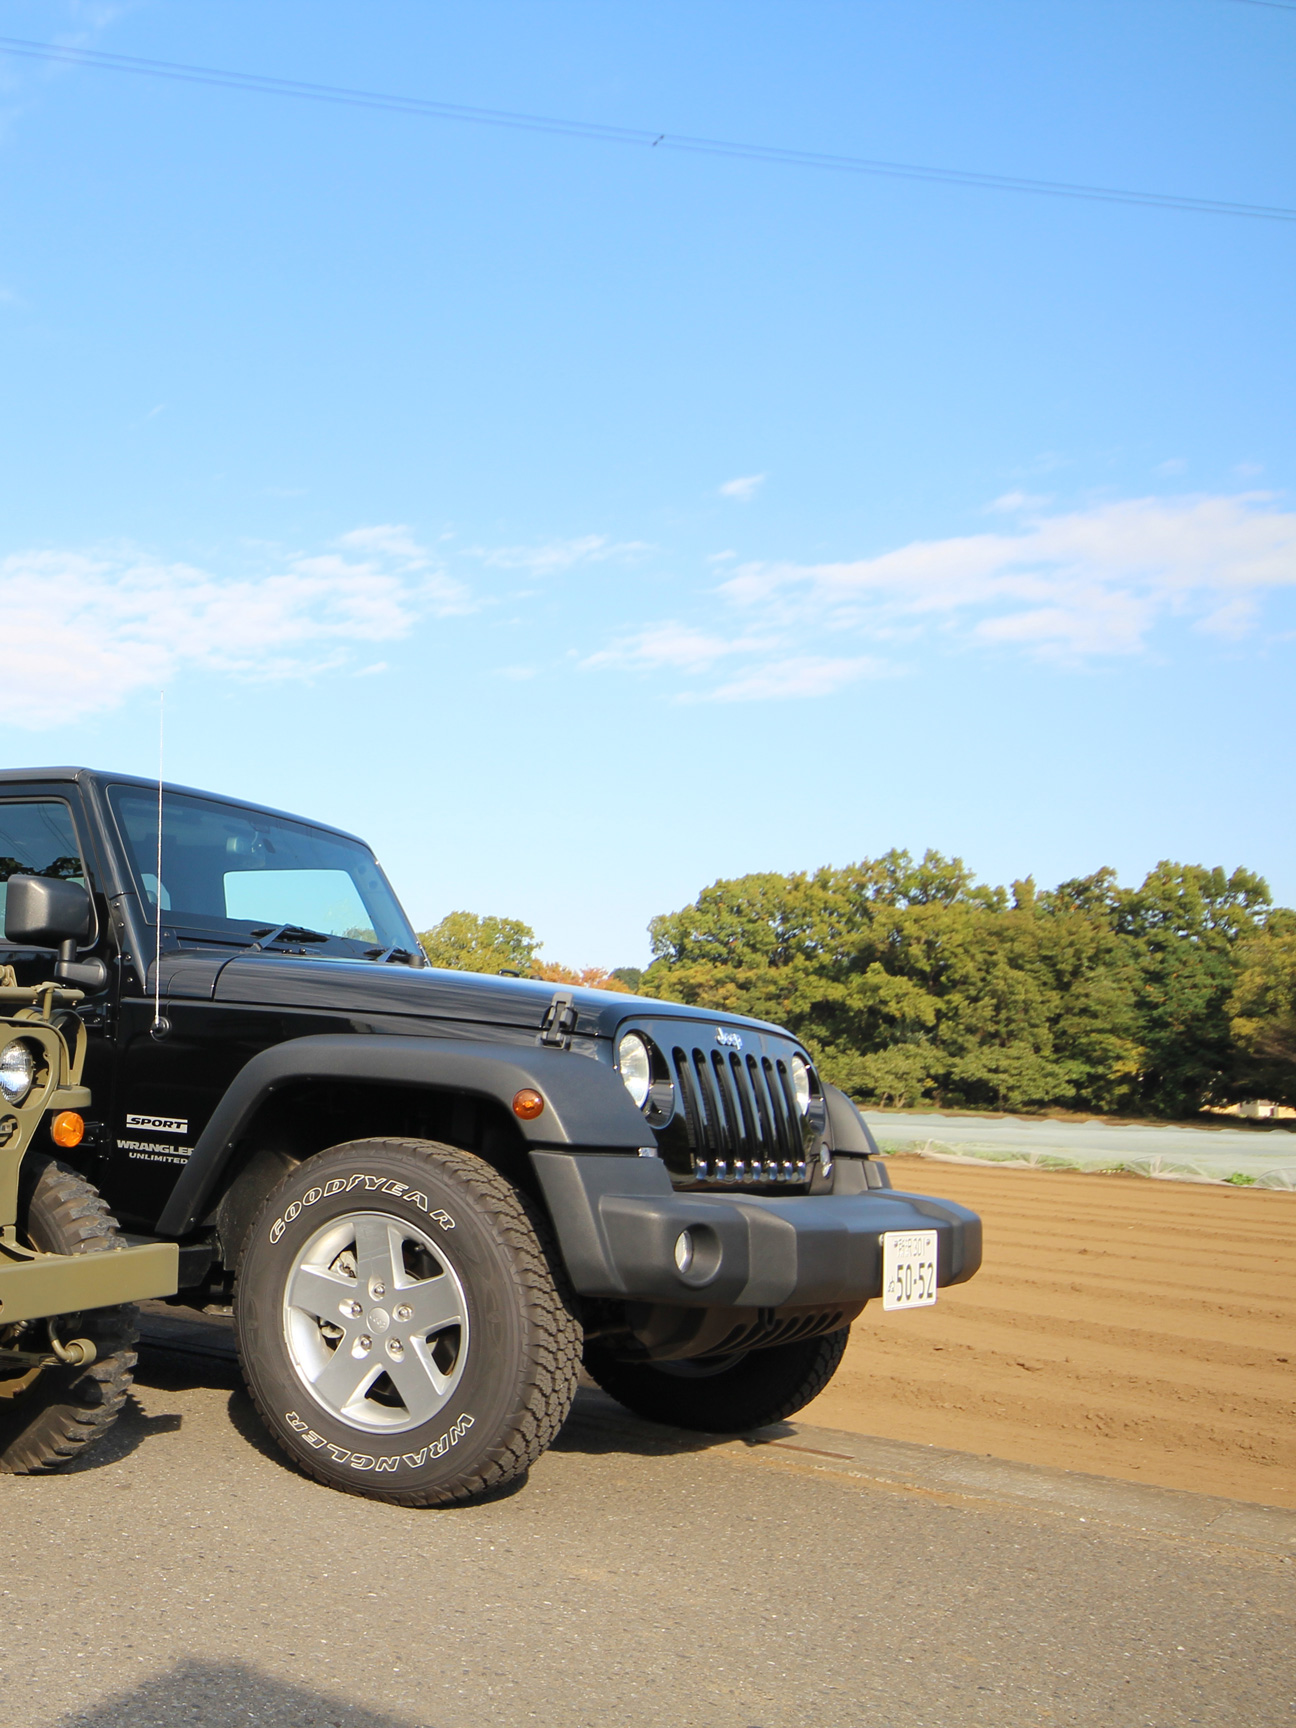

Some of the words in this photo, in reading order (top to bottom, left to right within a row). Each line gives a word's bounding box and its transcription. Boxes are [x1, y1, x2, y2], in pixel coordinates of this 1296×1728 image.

[715, 1027, 743, 1050] Jeep
[126, 1117, 188, 1129] SPORT
[128, 1152, 189, 1165] UNLIMITED
[269, 1174, 456, 1244] GOODYEAR
[895, 1262, 934, 1302] 50-52
[285, 1411, 476, 1472] WRANGLER
